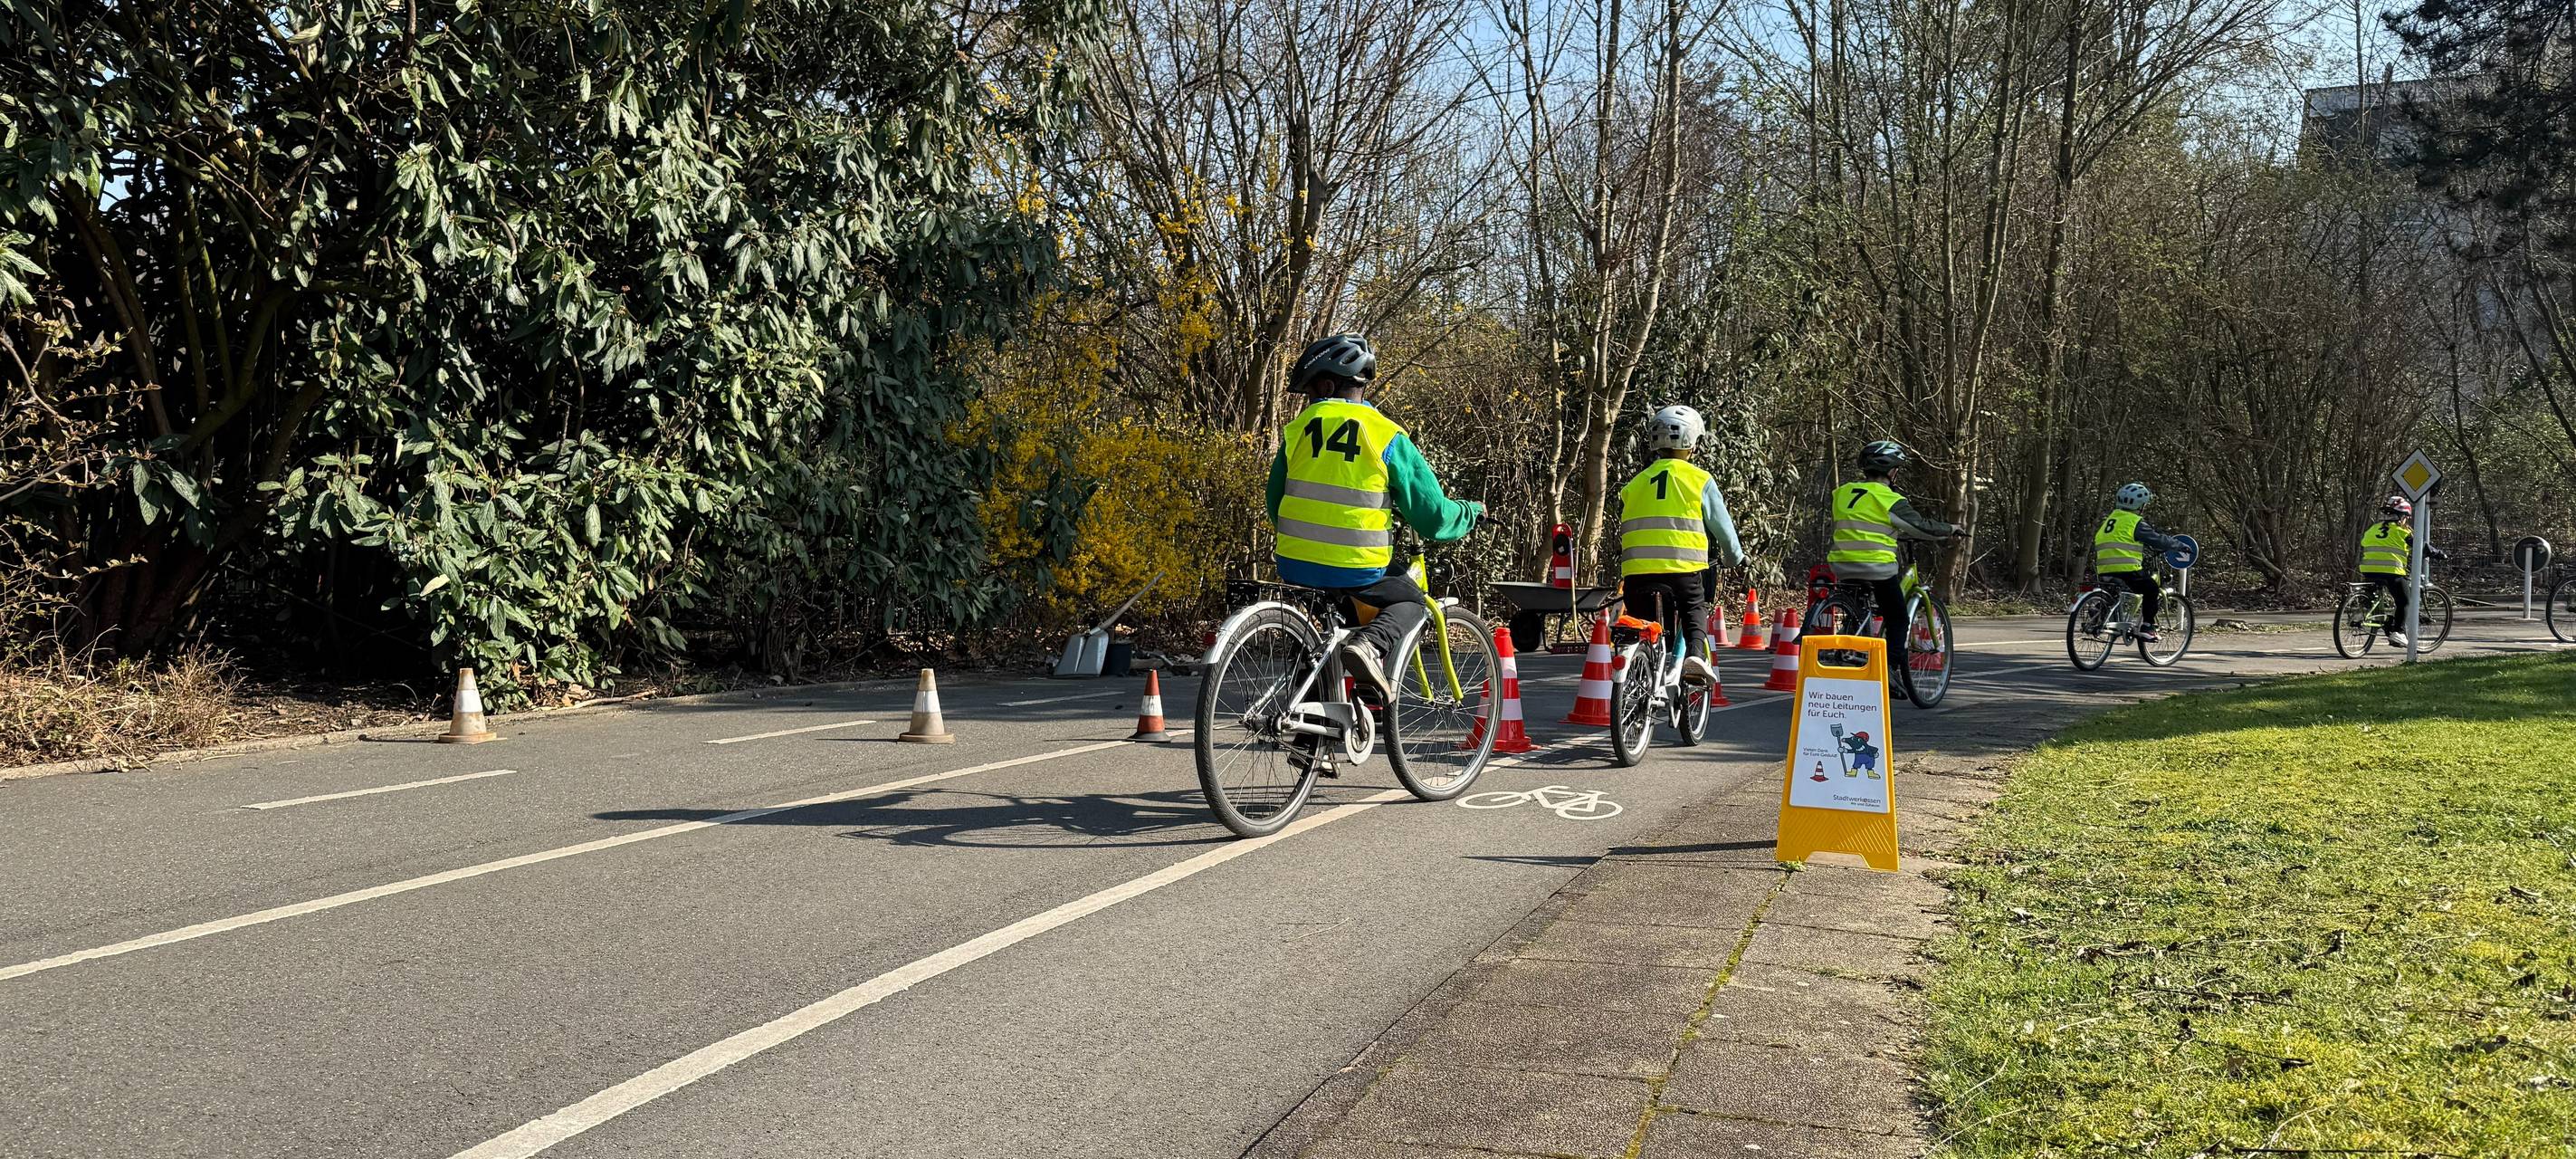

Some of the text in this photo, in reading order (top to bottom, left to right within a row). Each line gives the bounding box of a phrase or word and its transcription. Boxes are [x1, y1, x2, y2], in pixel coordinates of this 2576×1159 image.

[1304, 417, 1361, 463] 14
[1650, 470, 1669, 500] 1
[1847, 488, 1868, 509] 7
[2104, 519, 2117, 534] 8
[2375, 524, 2390, 539] 3
[1808, 691, 1854, 701] Wir bauen
[1808, 709, 1847, 719] für Euch.
[1832, 702, 1877, 713] Leitungen
